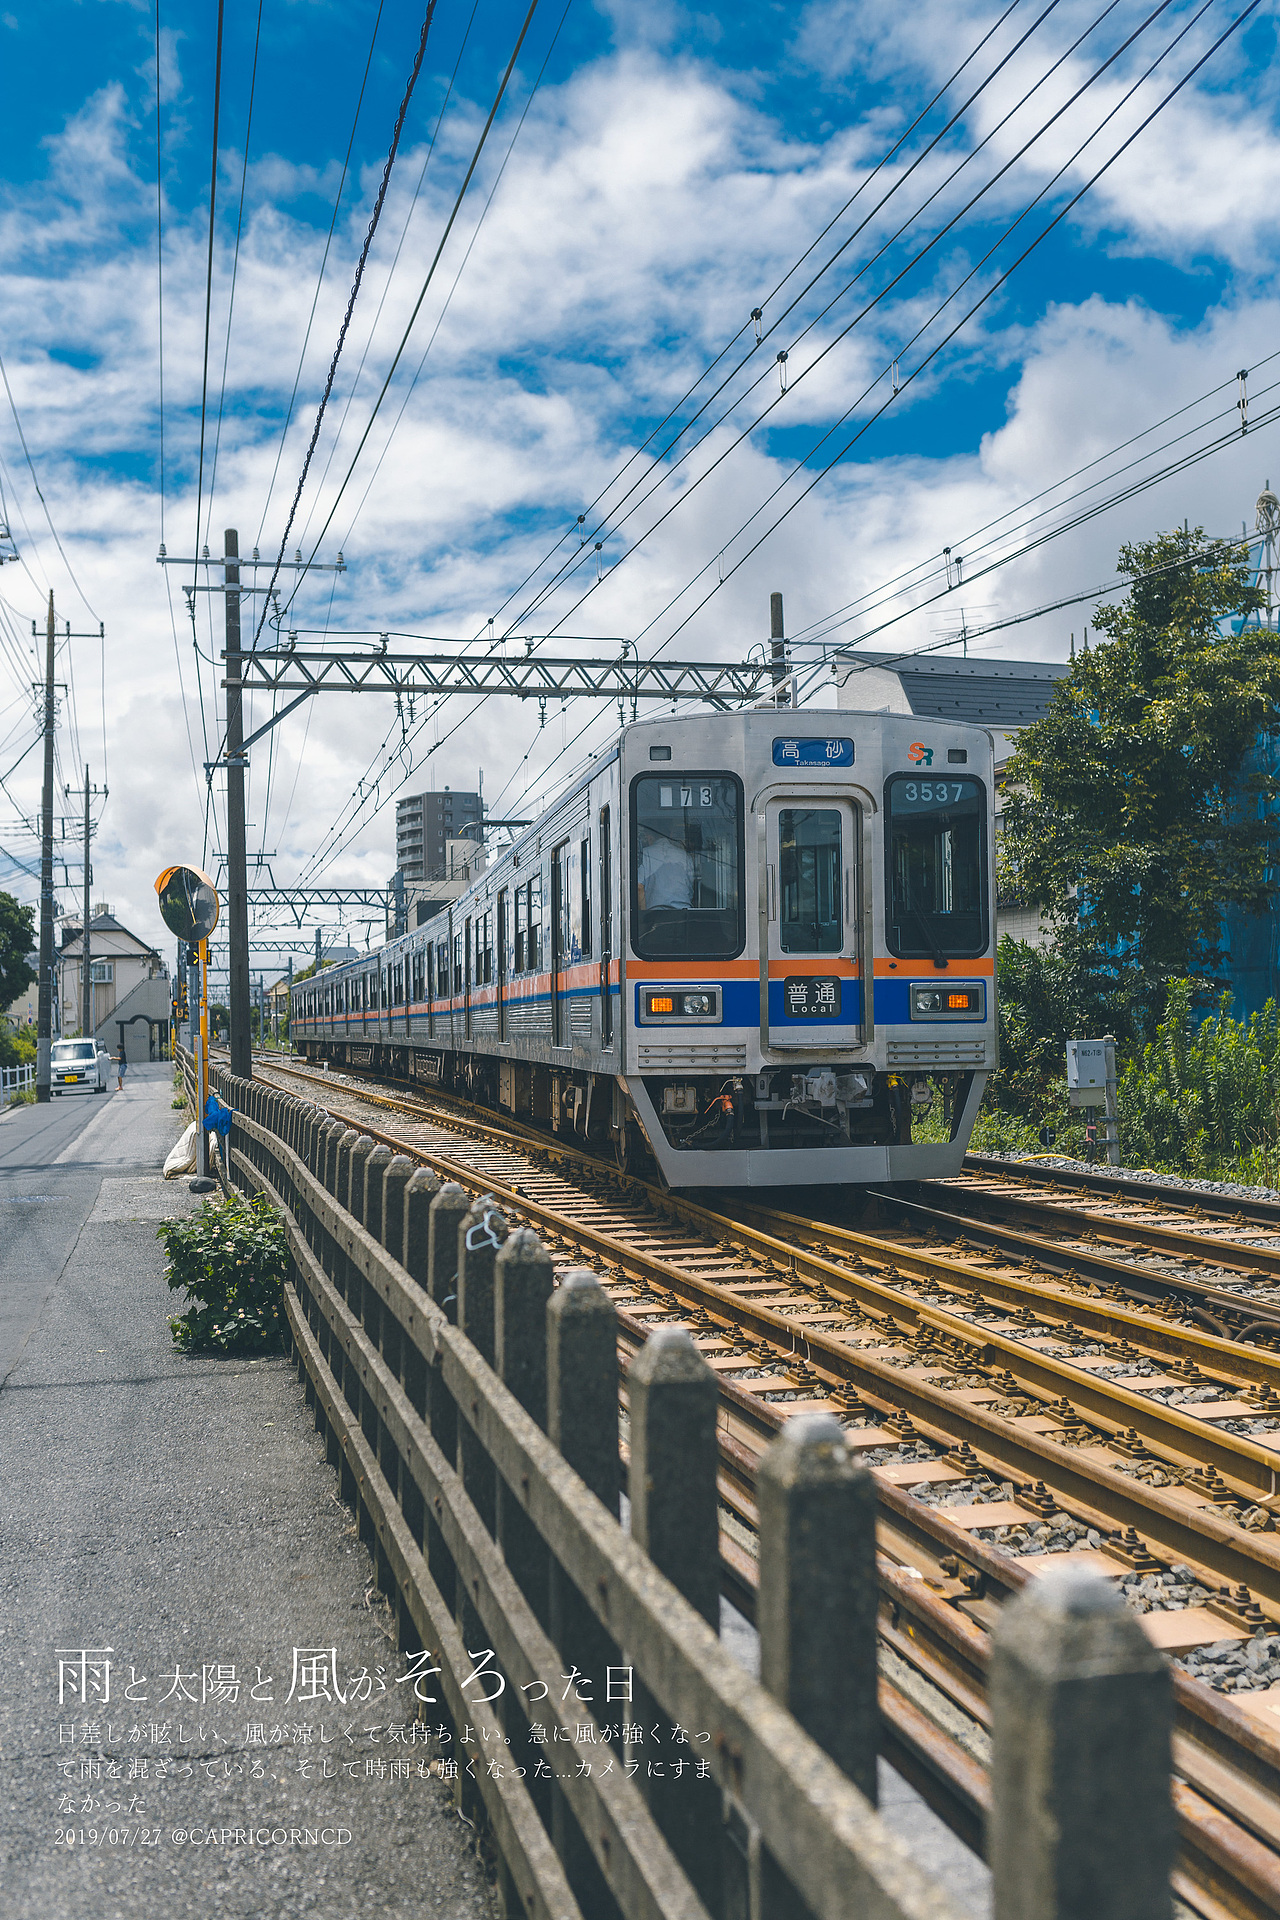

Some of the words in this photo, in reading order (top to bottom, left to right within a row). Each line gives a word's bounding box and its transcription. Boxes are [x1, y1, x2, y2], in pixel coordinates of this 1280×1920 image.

[794, 759, 831, 767] Takasago
[907, 742, 934, 766] SR
[905, 782, 963, 802] 3537
[787, 982, 836, 1004] 普通
[791, 1004, 832, 1013] Local
